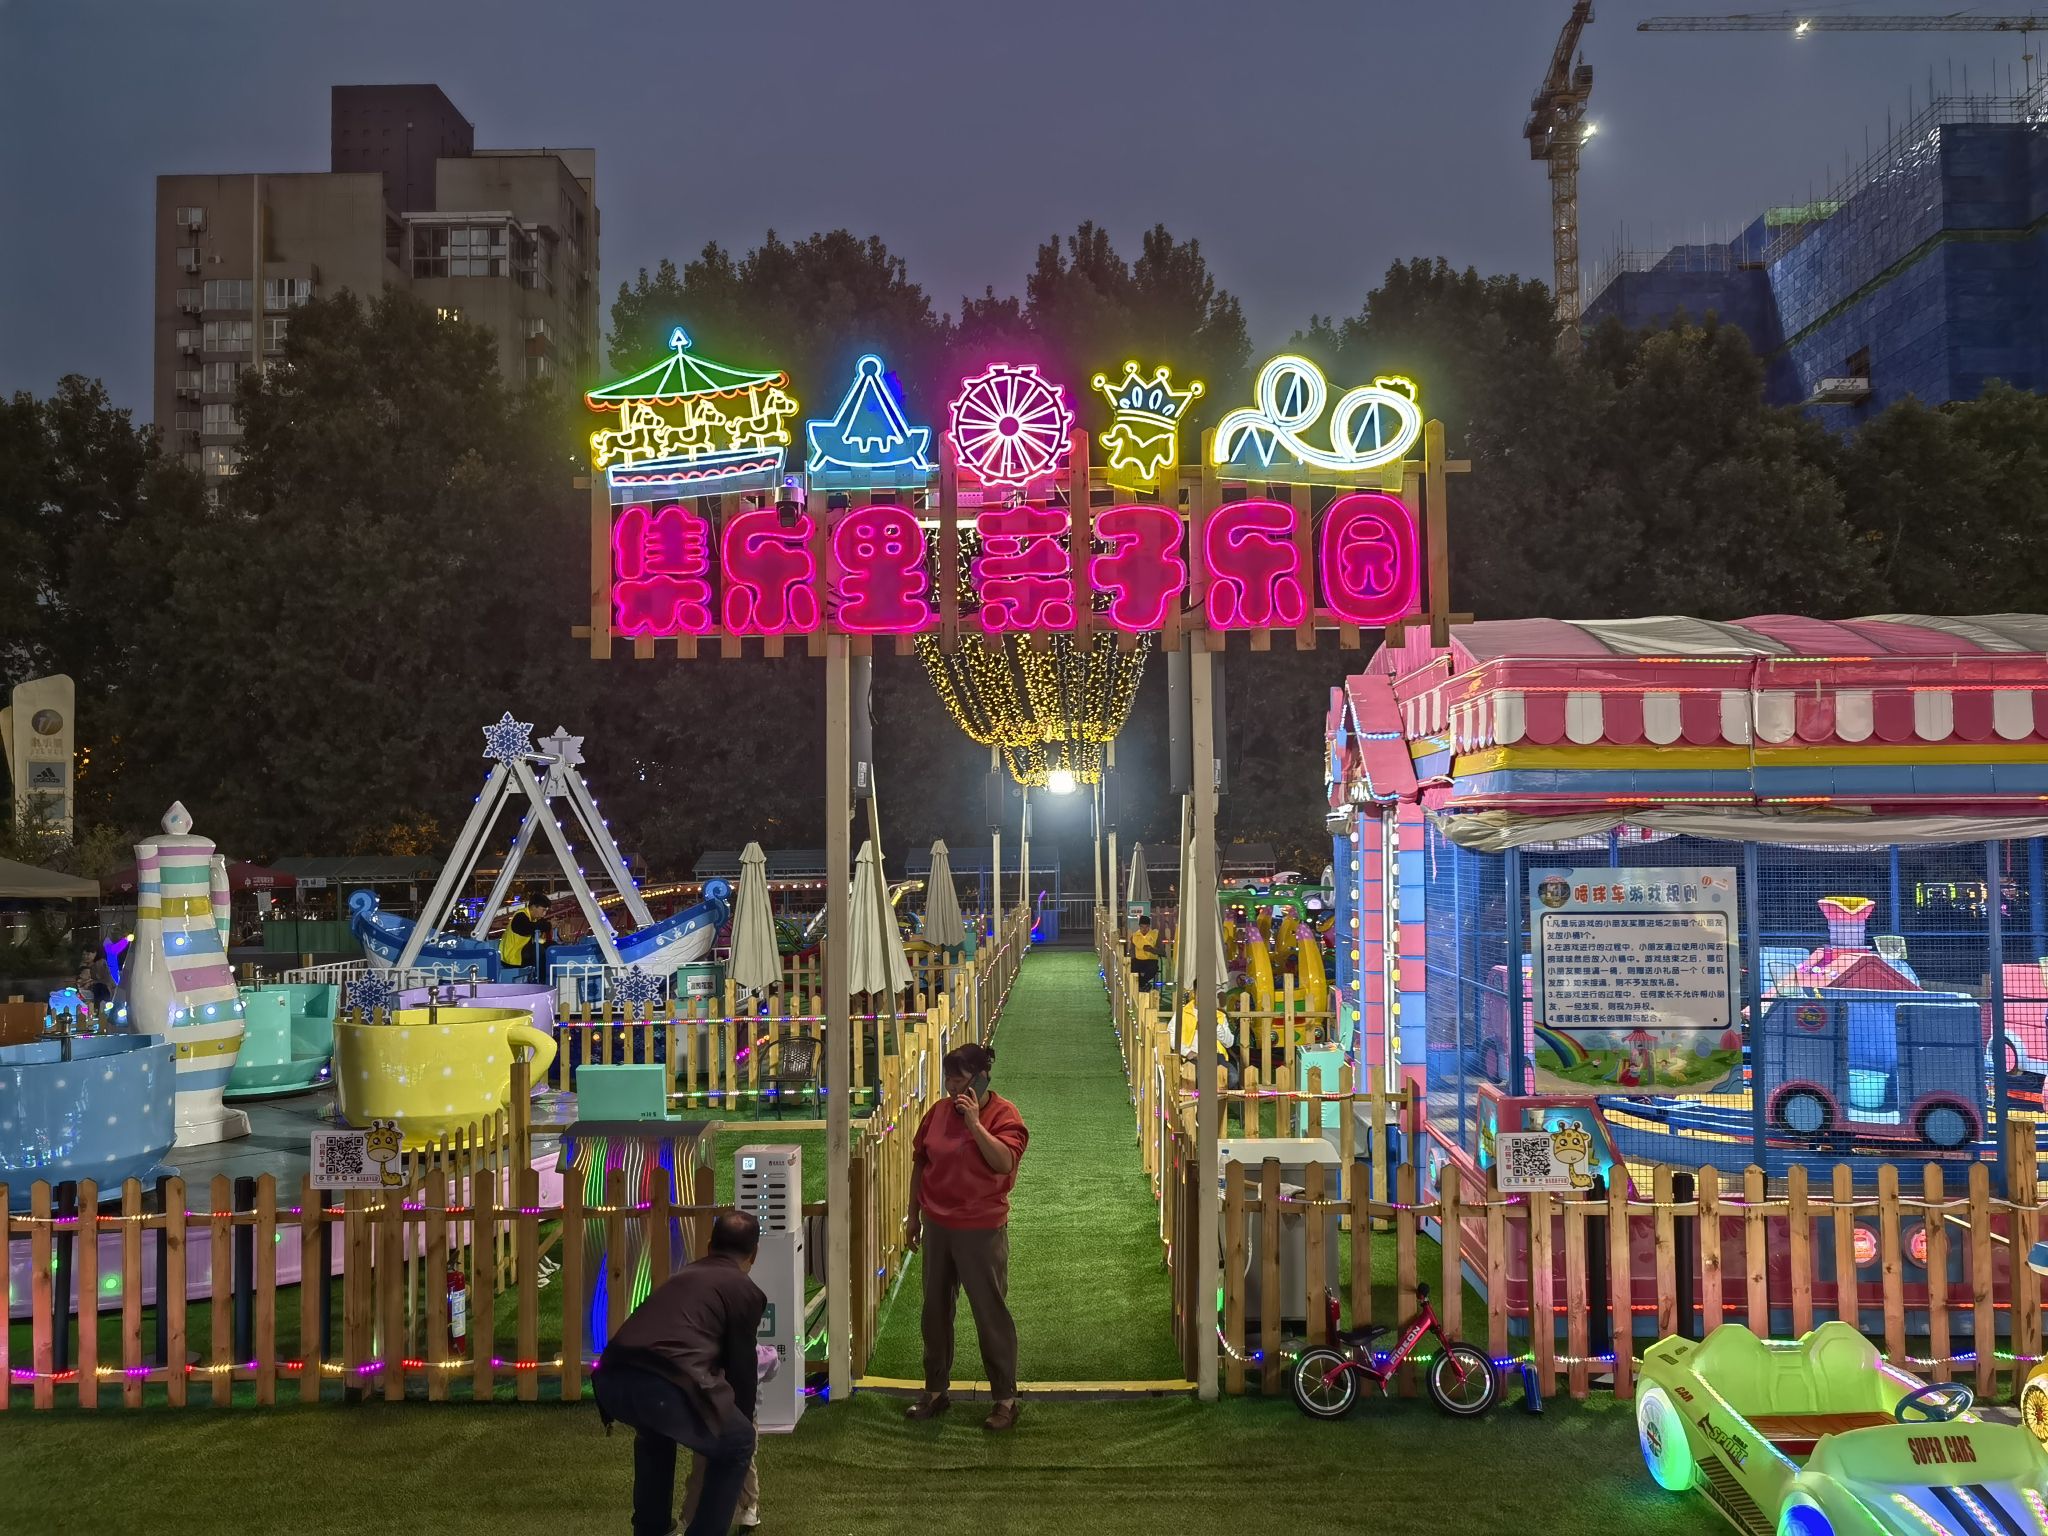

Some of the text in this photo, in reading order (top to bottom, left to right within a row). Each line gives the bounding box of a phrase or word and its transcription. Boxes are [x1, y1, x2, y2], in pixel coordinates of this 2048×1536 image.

[612, 492, 1421, 636] 集乐里亲子乐园
[1390, 1326, 1421, 1364] PIGEON
[1709, 1426, 1749, 1463] SPORT
[1907, 1435, 1977, 1465] SUPER CARS
